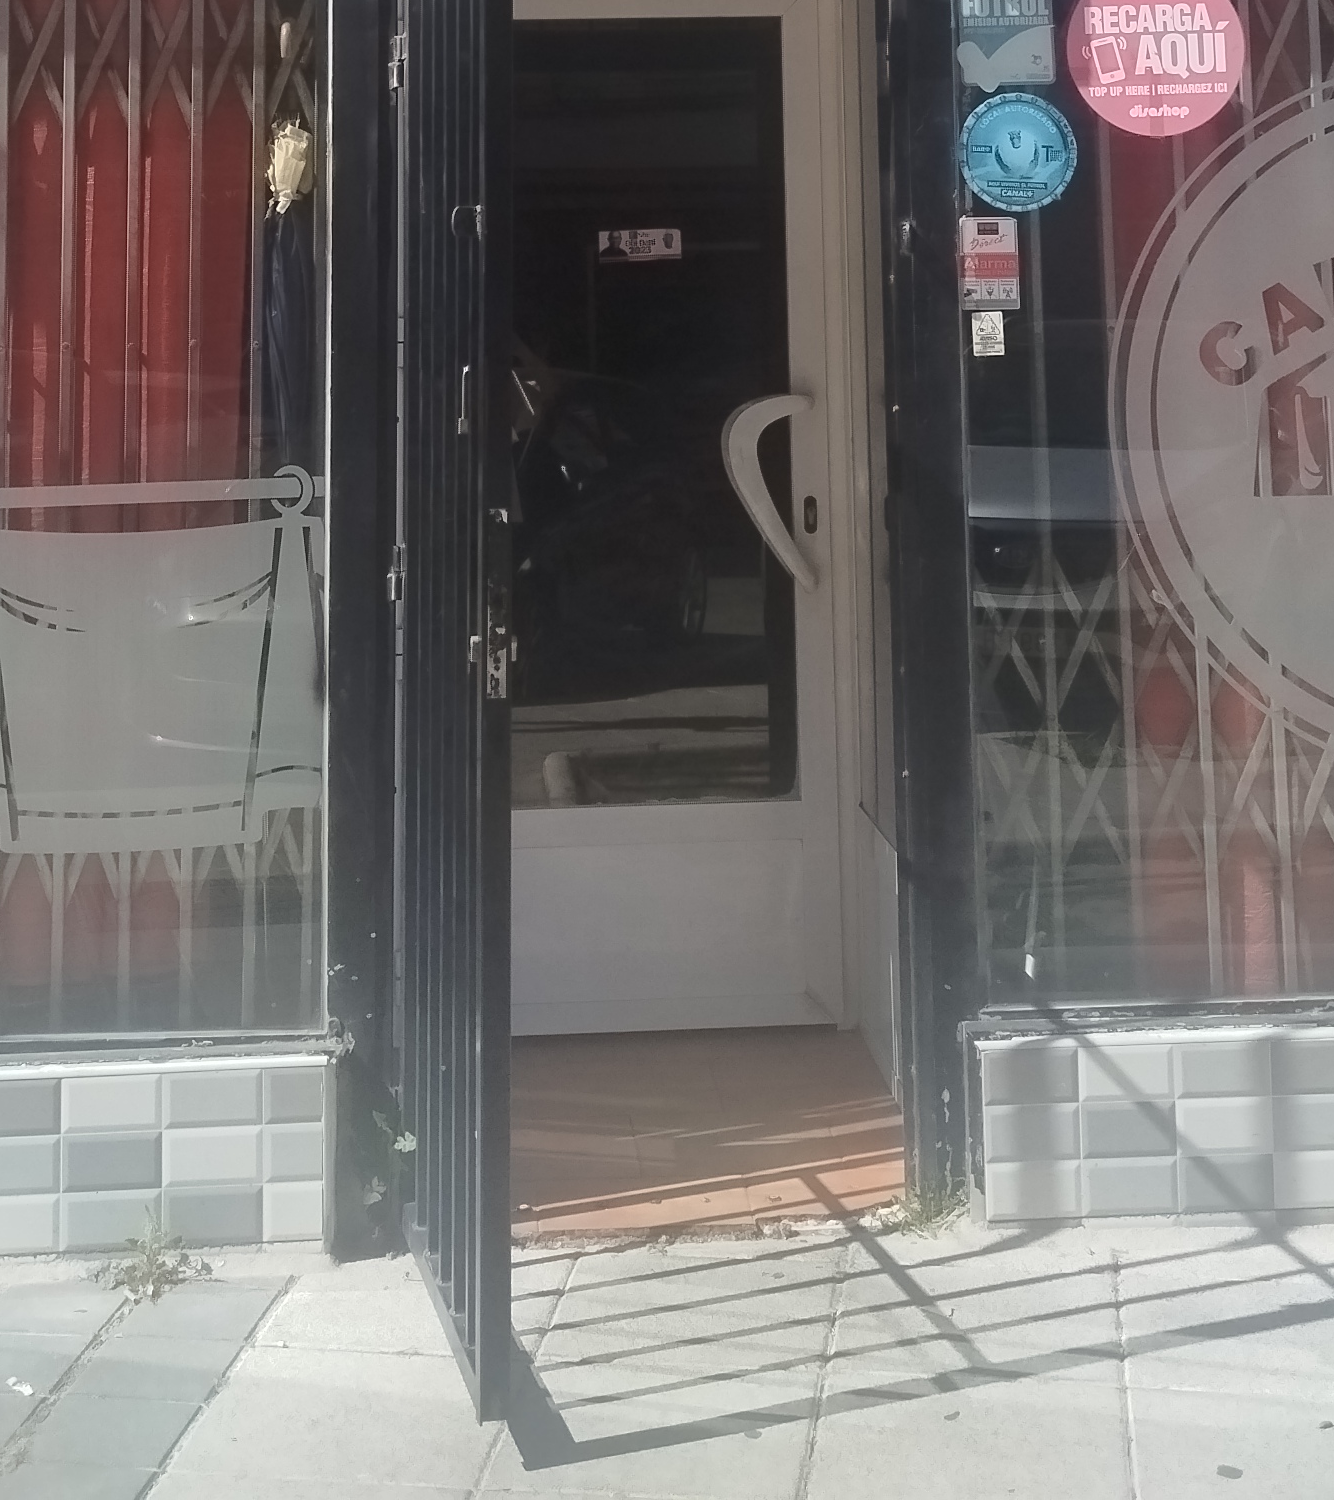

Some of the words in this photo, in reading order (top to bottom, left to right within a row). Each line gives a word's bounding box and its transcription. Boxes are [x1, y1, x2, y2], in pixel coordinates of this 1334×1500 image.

[1084, 3, 1213, 35] RECARGA
[1135, 21, 1230, 79] AQUÍ
[1089, 87, 1107, 97] TOP
[1110, 86, 1123, 97] UP
[1125, 85, 1150, 96] HERE
[1157, 84, 1212, 95] RECHARGEZ
[1215, 83, 1228, 93] ICI
[1005, 105, 1057, 134] AUTORIZADO
[1129, 104, 1190, 119] disashop
[628, 246, 652, 254] 2023
